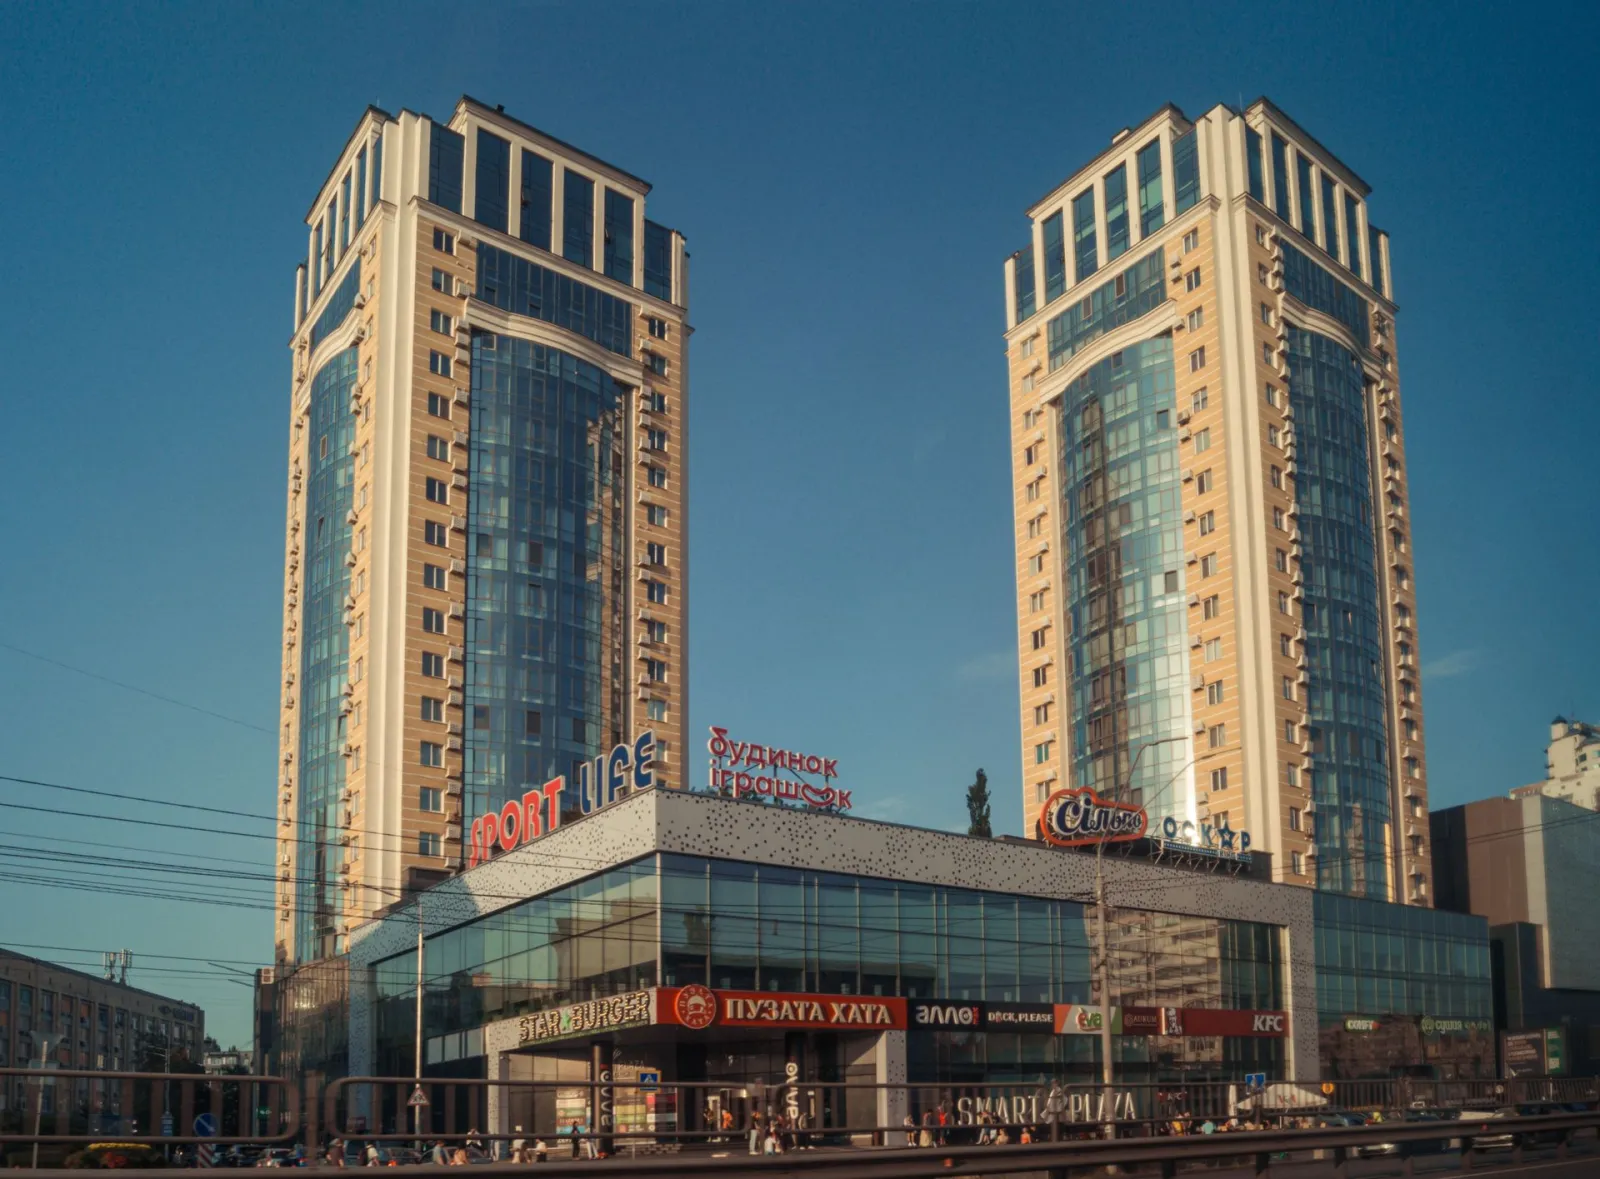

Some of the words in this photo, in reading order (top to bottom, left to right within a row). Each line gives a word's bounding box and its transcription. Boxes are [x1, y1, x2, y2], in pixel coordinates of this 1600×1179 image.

[707, 726, 837, 777] будинок
[469, 775, 566, 869] SPORT
[579, 729, 657, 816] LIFE
[1053, 796, 1142, 836] Сільпо
[519, 1009, 561, 1041] STAR
[571, 990, 651, 1031] BURGER
[724, 998, 826, 1022] ПУЗАТА
[829, 1001, 894, 1025] ХАТА
[1252, 1014, 1284, 1032] KFC
[957, 1095, 1040, 1125] SMART
